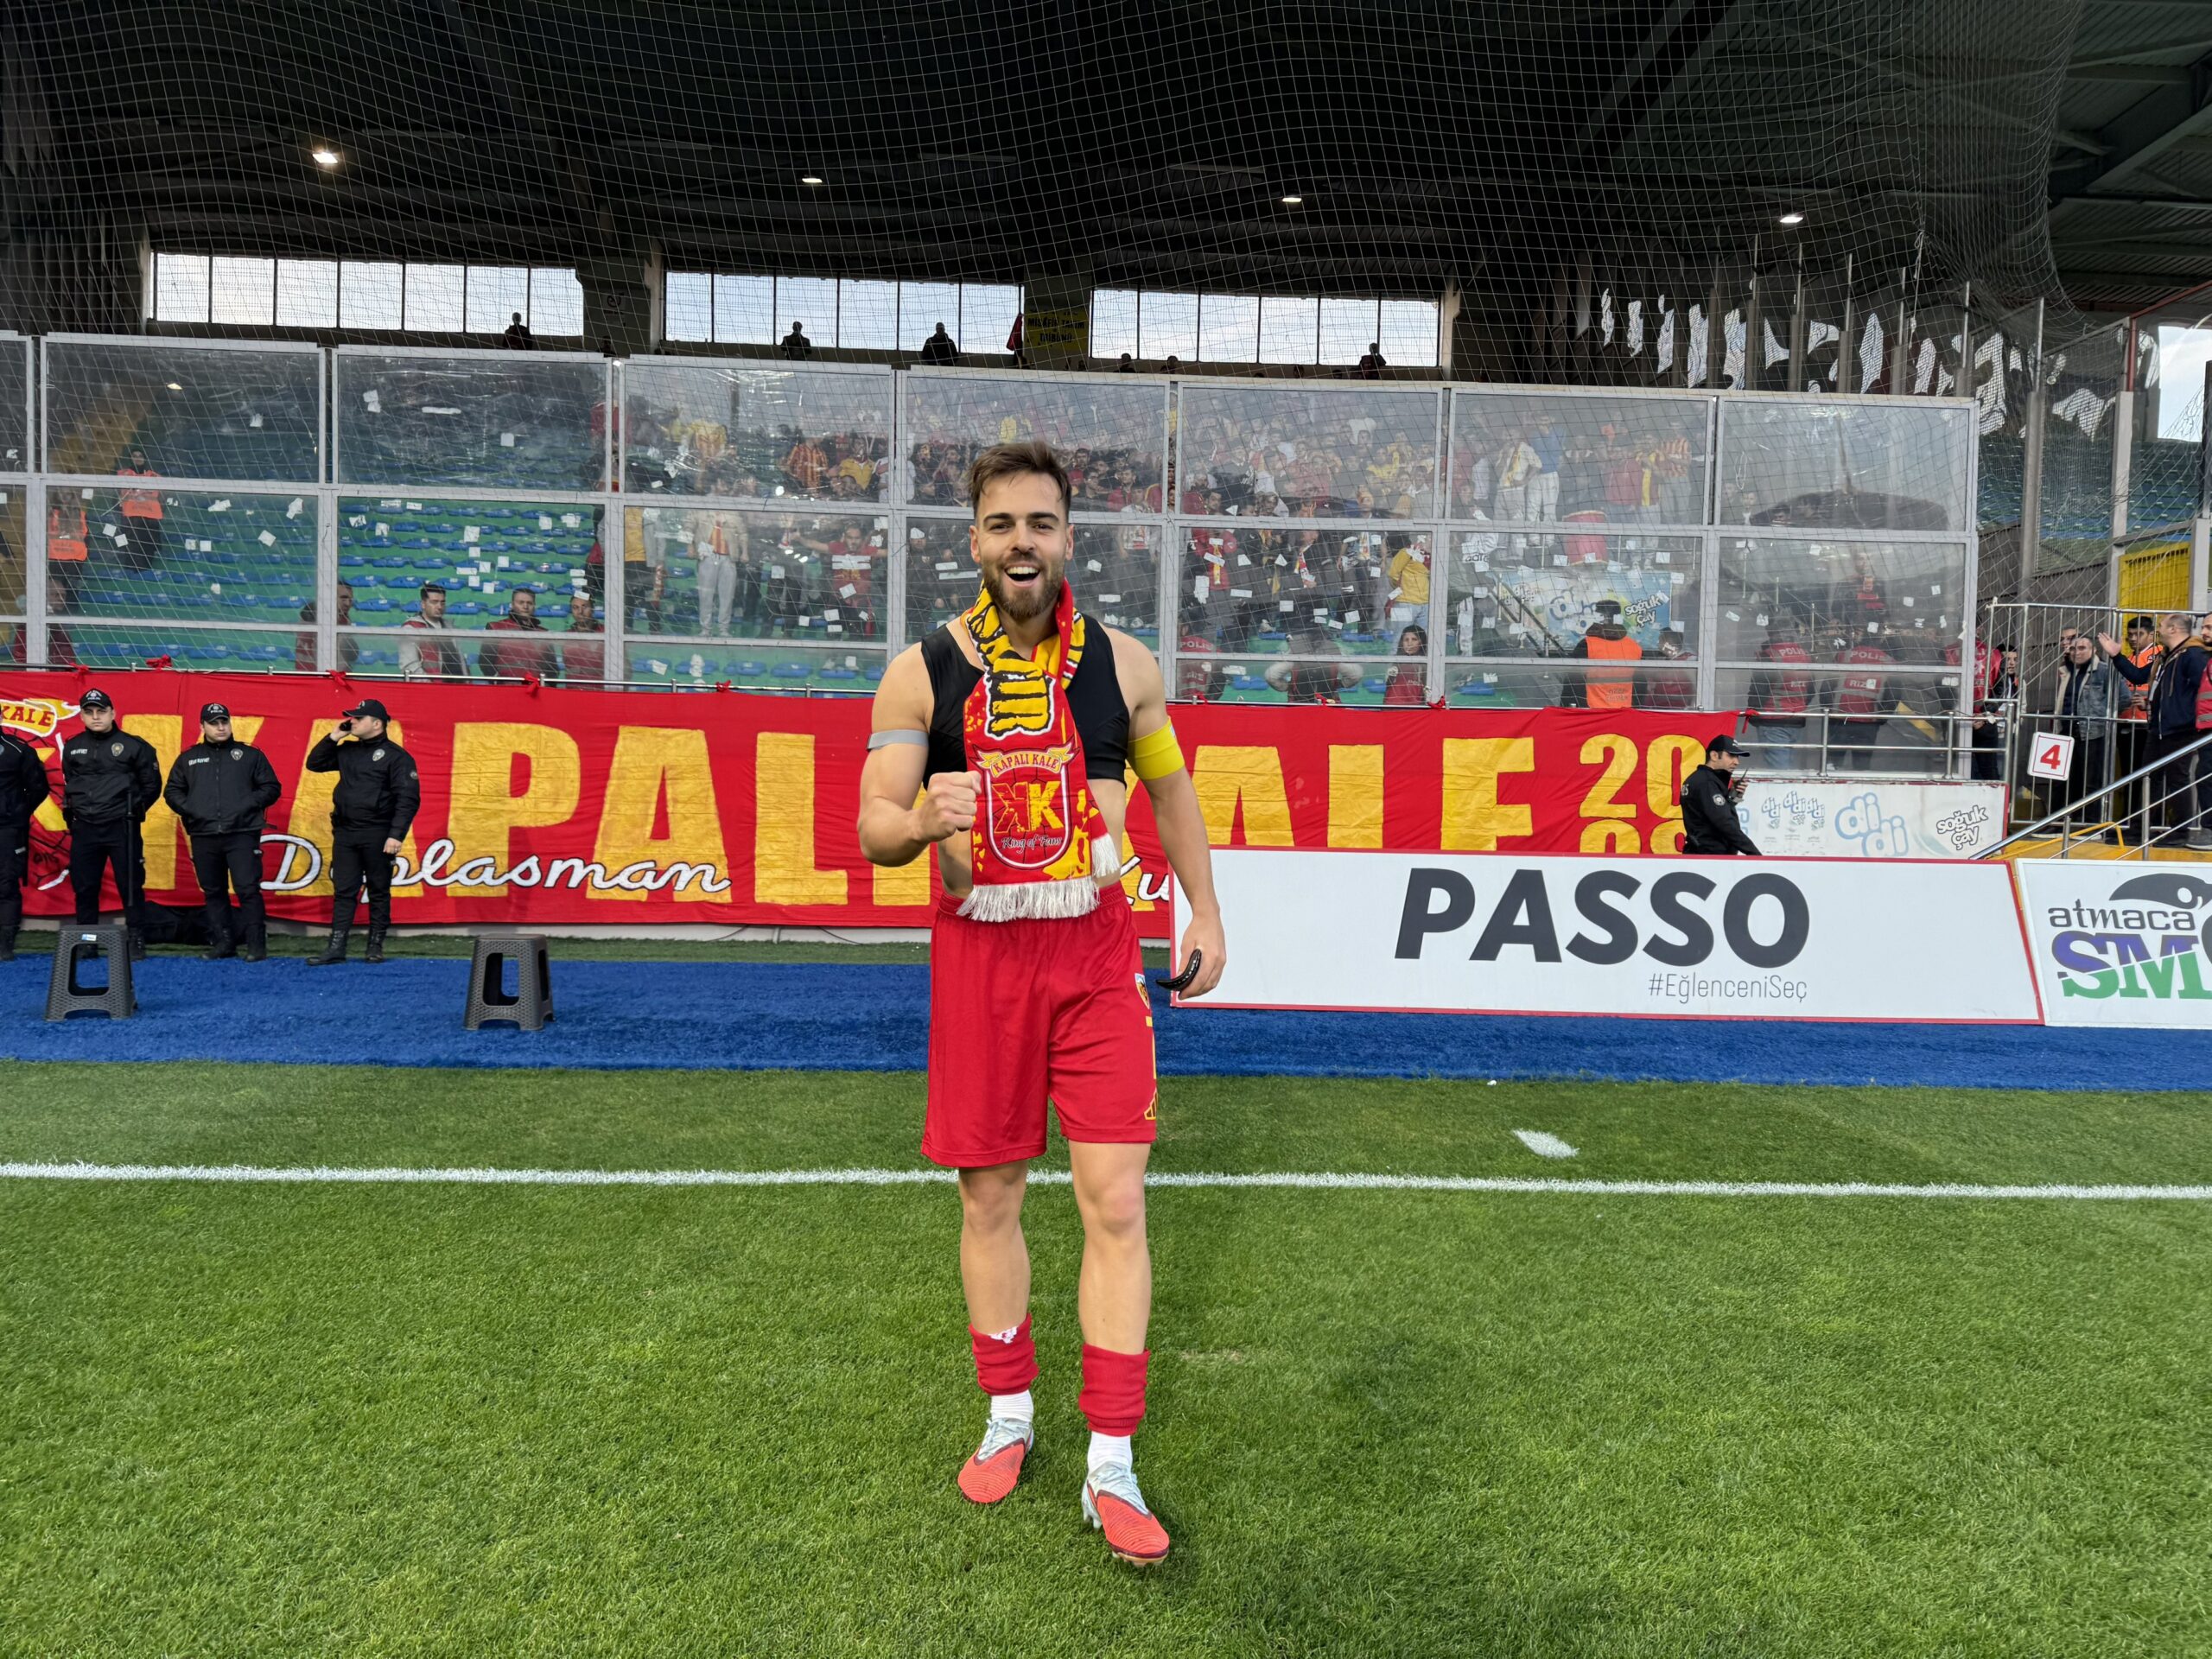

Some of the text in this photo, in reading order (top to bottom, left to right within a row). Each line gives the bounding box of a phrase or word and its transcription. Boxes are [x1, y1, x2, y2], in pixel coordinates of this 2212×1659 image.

[993, 753, 1059, 773] KAPALI KALE
[2039, 744, 2062, 770] 4
[1936, 805, 1988, 834] soğuk
[1001, 836, 1027, 854] King
[1027, 834, 1038, 849] of
[1951, 825, 1980, 850] çay
[1394, 867, 1810, 969] PASSO
[2048, 899, 2196, 931] atmaca
[1648, 971, 1808, 1004] #EğlenceniSeç
